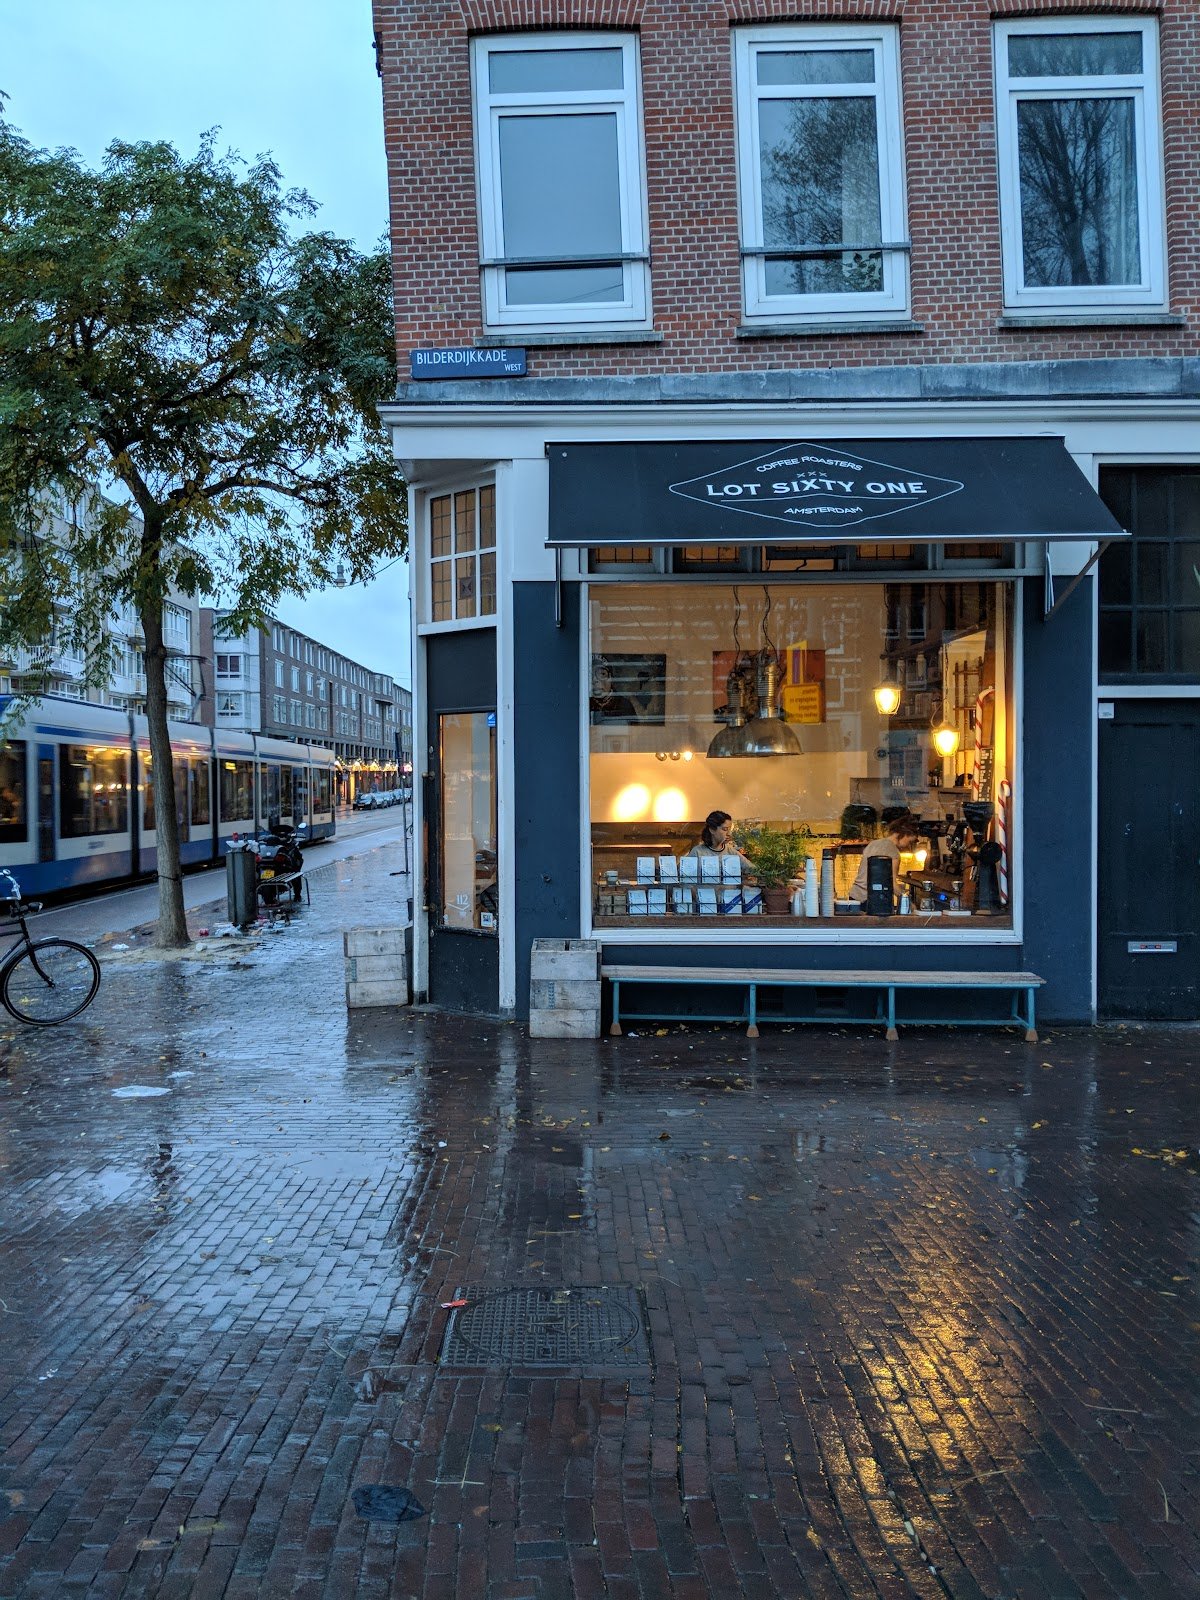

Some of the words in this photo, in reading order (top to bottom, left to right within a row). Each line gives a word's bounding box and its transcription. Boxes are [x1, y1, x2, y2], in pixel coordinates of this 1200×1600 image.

[416, 349, 507, 366] BILDERDIJKKADE
[504, 363, 522, 371] WEST
[756, 457, 800, 473] COFFEE
[801, 455, 864, 472] ROASTERS
[706, 483, 761, 496] LOT
[772, 478, 855, 495] SIXTY
[866, 481, 928, 494] ONE
[783, 506, 864, 515] AMSTERDAM
[456, 894, 469, 905] 112
